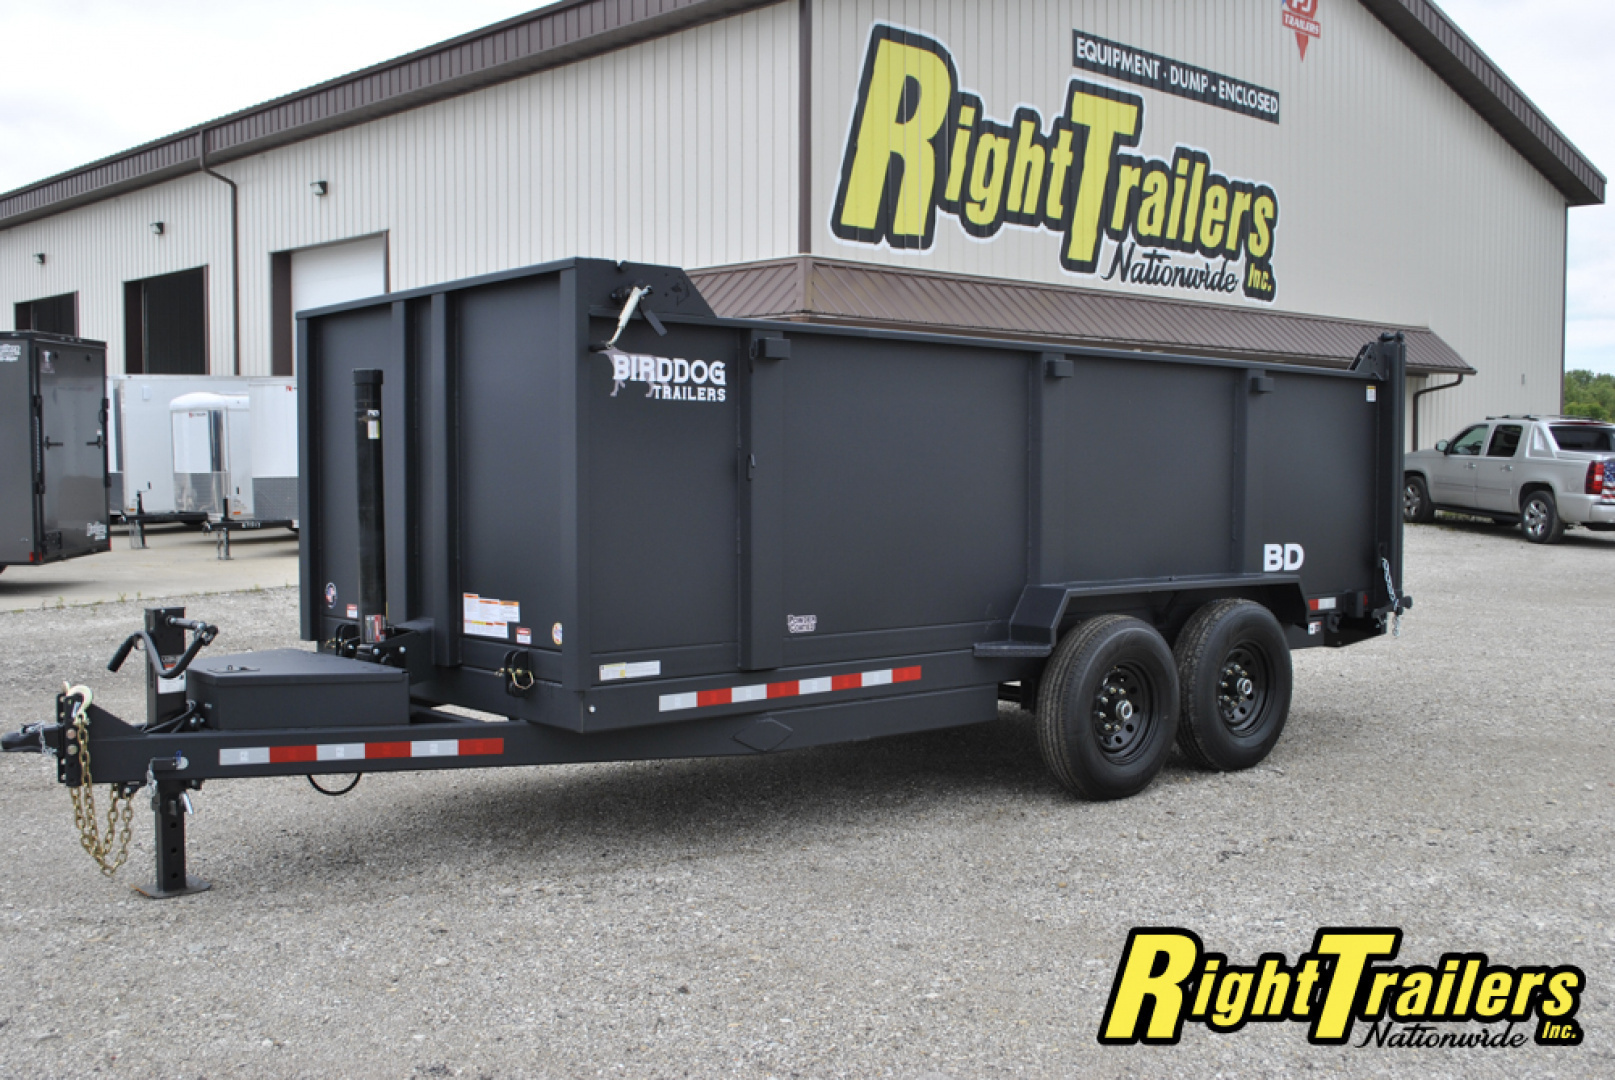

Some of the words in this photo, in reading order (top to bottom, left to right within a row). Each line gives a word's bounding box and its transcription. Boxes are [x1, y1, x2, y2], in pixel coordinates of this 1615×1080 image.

[1284, 14, 1319, 35] TRAILERS
[1076, 36, 1160, 80] EQUIPMENT
[1170, 65, 1209, 93] DUMP
[1218, 79, 1279, 114] ENCLOSED
[1100, 242, 1239, 293] Nationwide
[1247, 262, 1272, 293] Inc.
[612, 354, 726, 385] BIRDDOG
[653, 384, 726, 402] TRAILERS
[1263, 543, 1305, 572] BD
